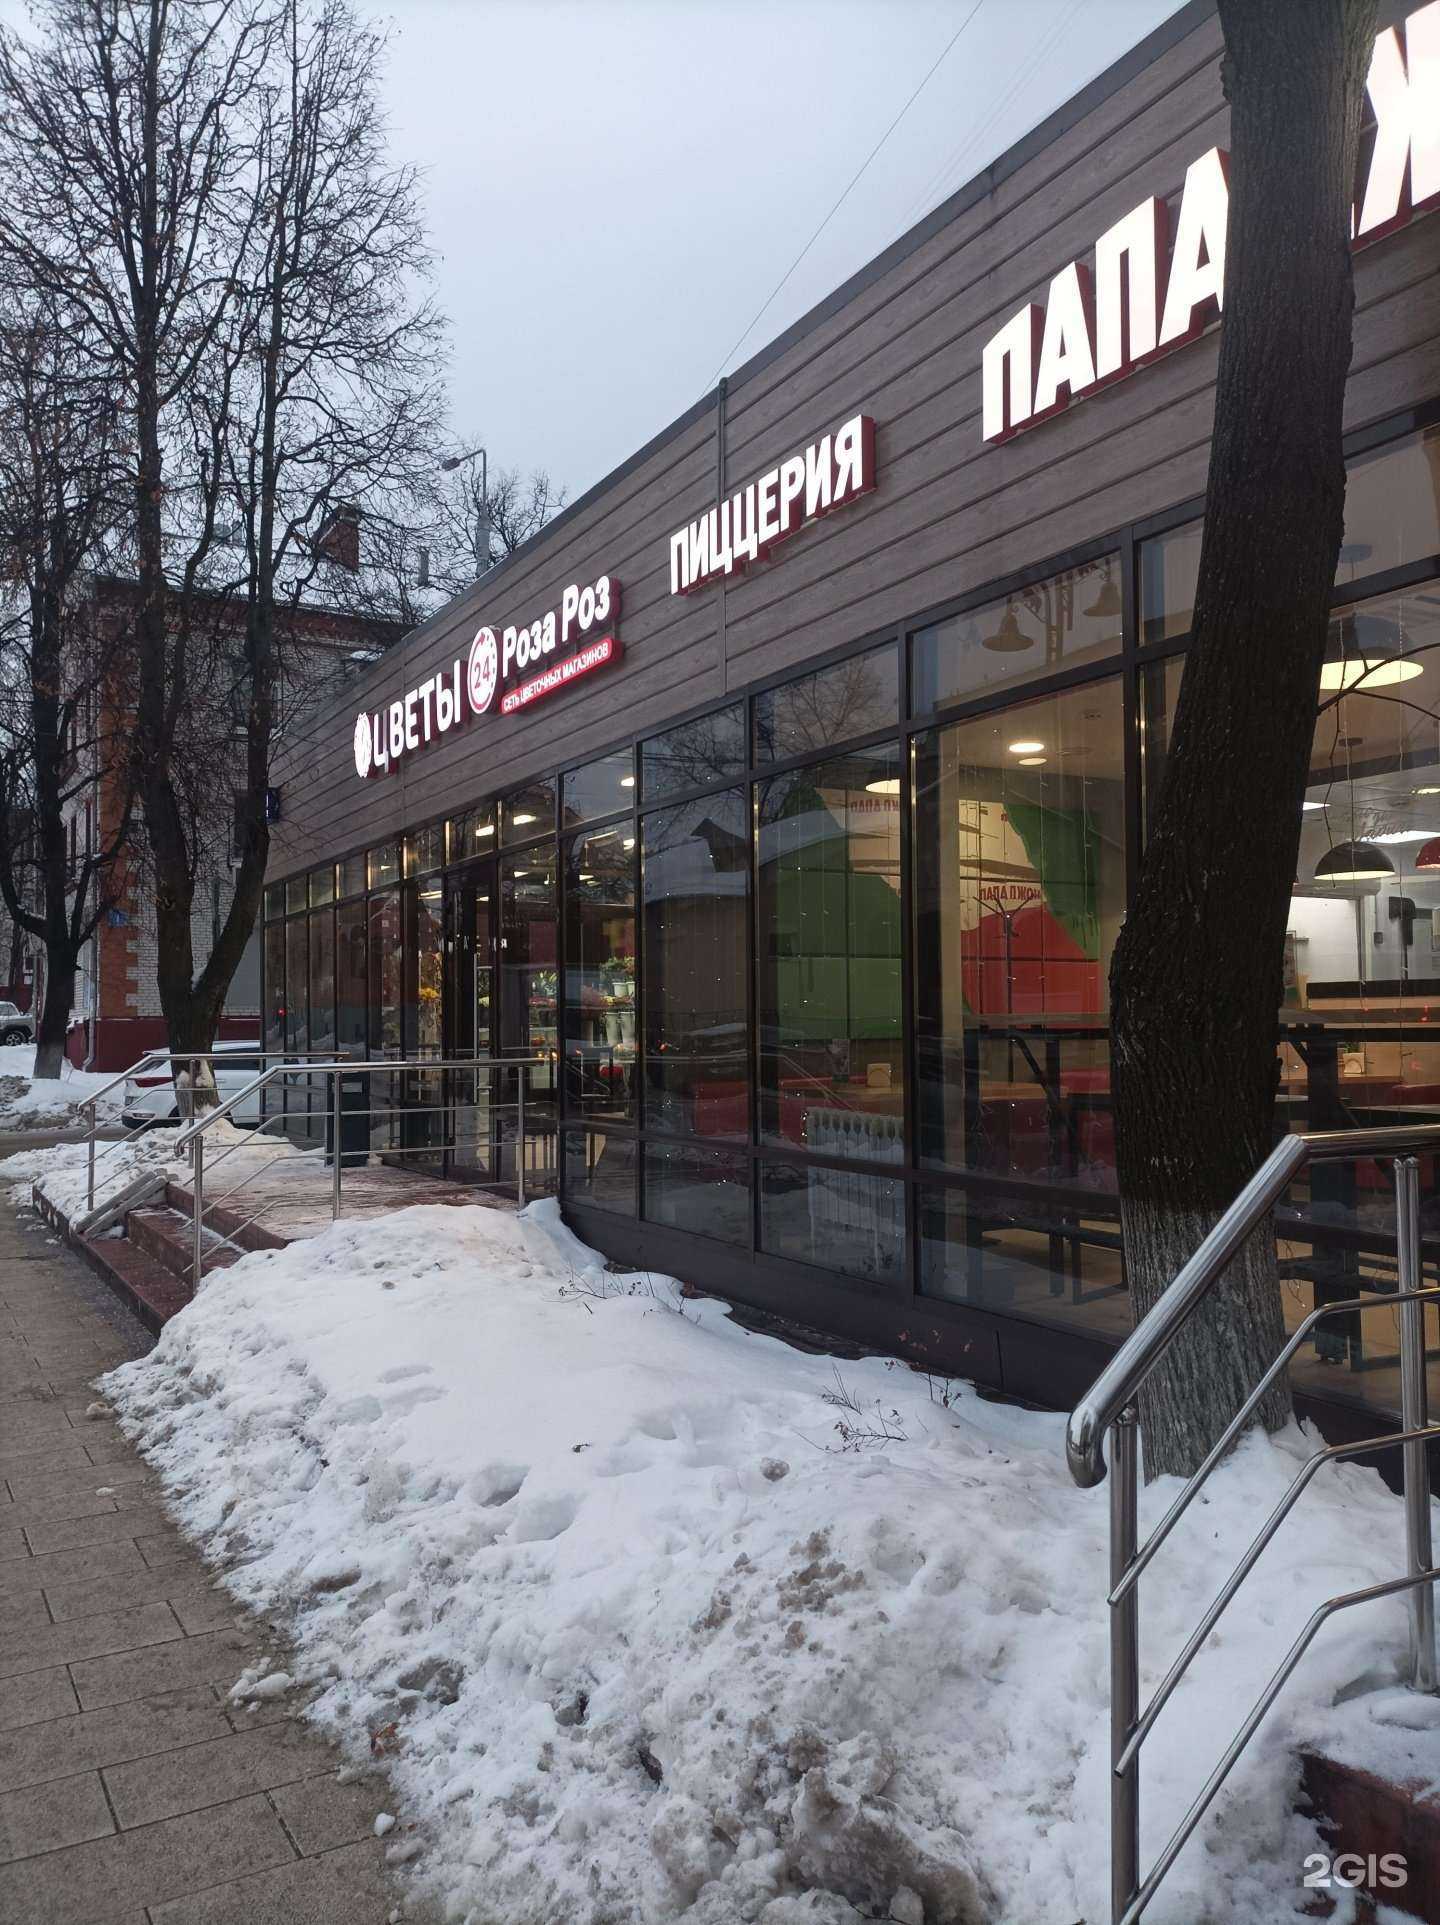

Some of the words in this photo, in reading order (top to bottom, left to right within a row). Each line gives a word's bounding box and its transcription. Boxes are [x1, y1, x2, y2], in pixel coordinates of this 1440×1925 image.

[983, 147, 1229, 443] ПАПА
[670, 414, 863, 595] ПИЦЦЕРИЯ
[371, 659, 461, 773] ЦВЕТЫ
[474, 655, 490, 689] 24
[502, 611, 556, 678] Роза
[562, 575, 611, 643] Роз
[520, 669, 562, 704] ЦВЕТОЧНЫХ
[562, 642, 609, 679] МАГАЗИНОВ
[980, 885, 1008, 901] ПАПА
